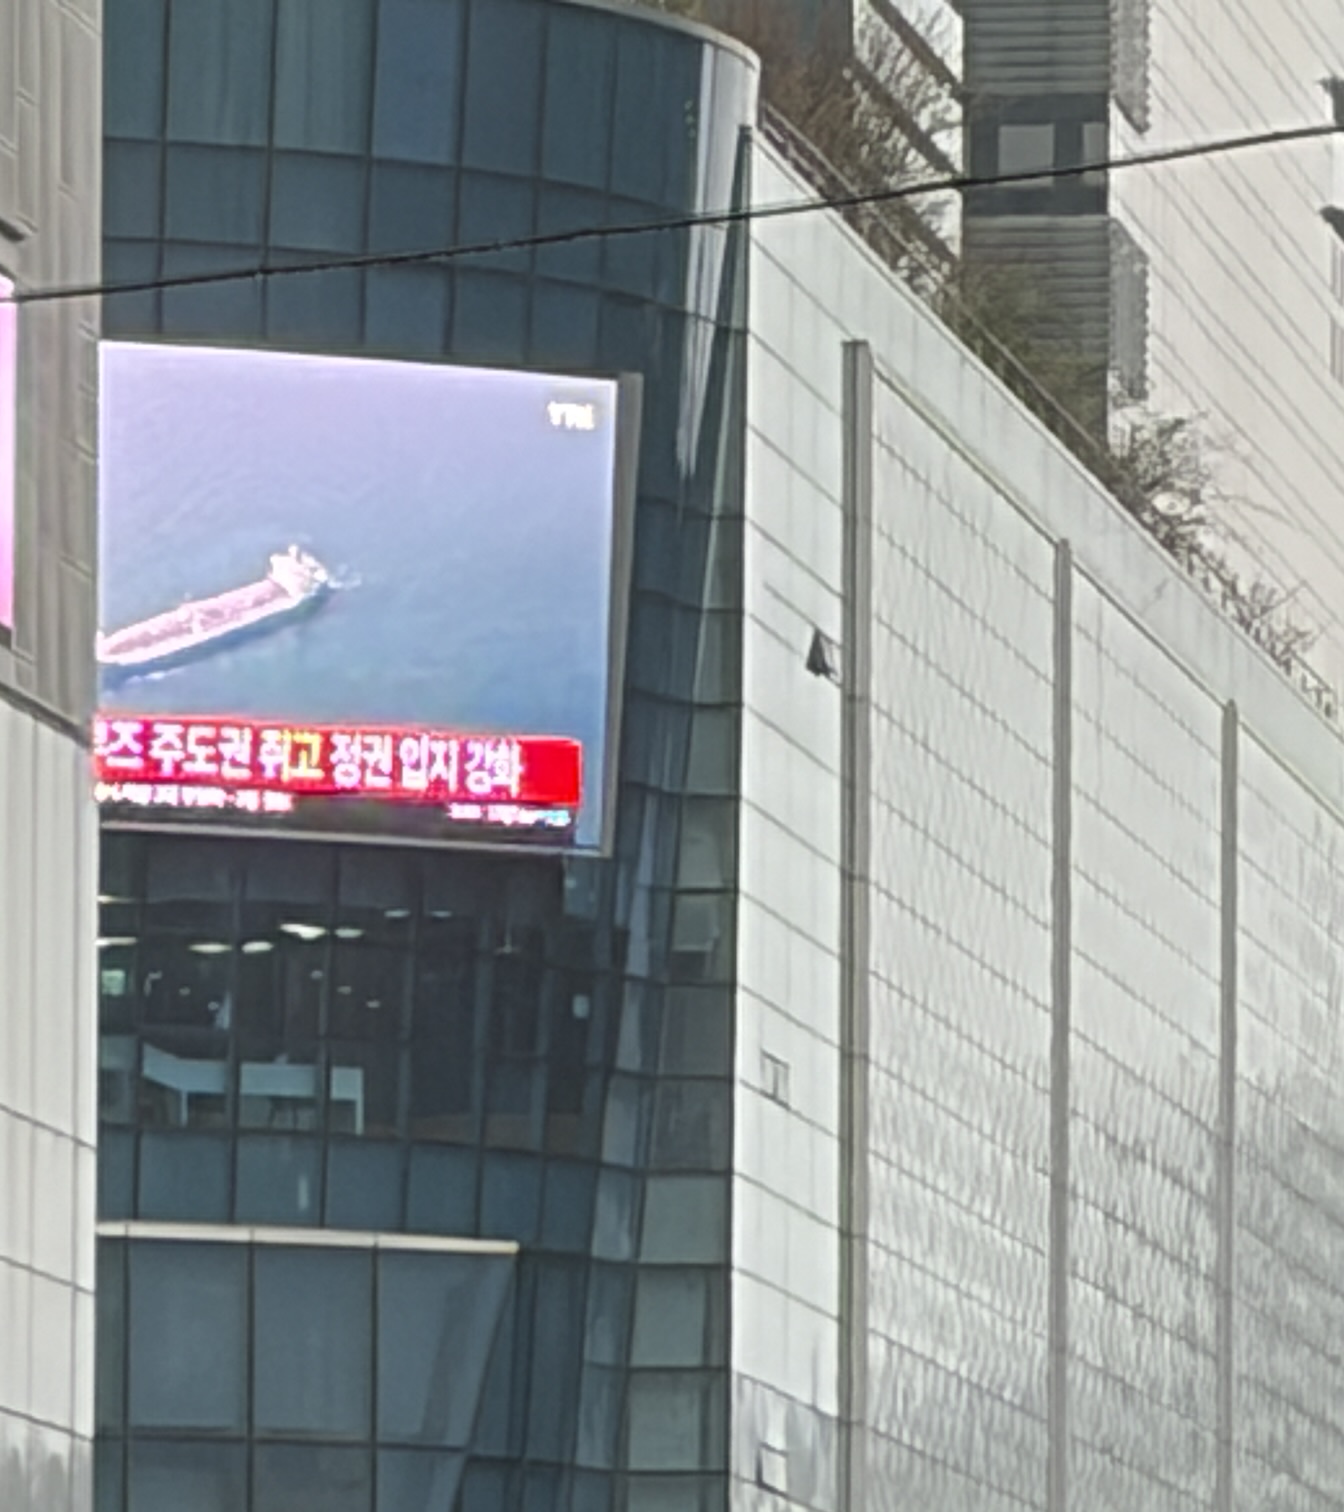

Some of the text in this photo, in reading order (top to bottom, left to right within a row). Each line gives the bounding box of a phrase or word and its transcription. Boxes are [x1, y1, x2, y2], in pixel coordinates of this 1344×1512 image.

[149, 722, 253, 779] 주도권
[259, 727, 325, 783] 쥐고
[330, 733, 394, 788] 정권
[399, 734, 459, 793] 입지
[464, 736, 524, 798] 강화
